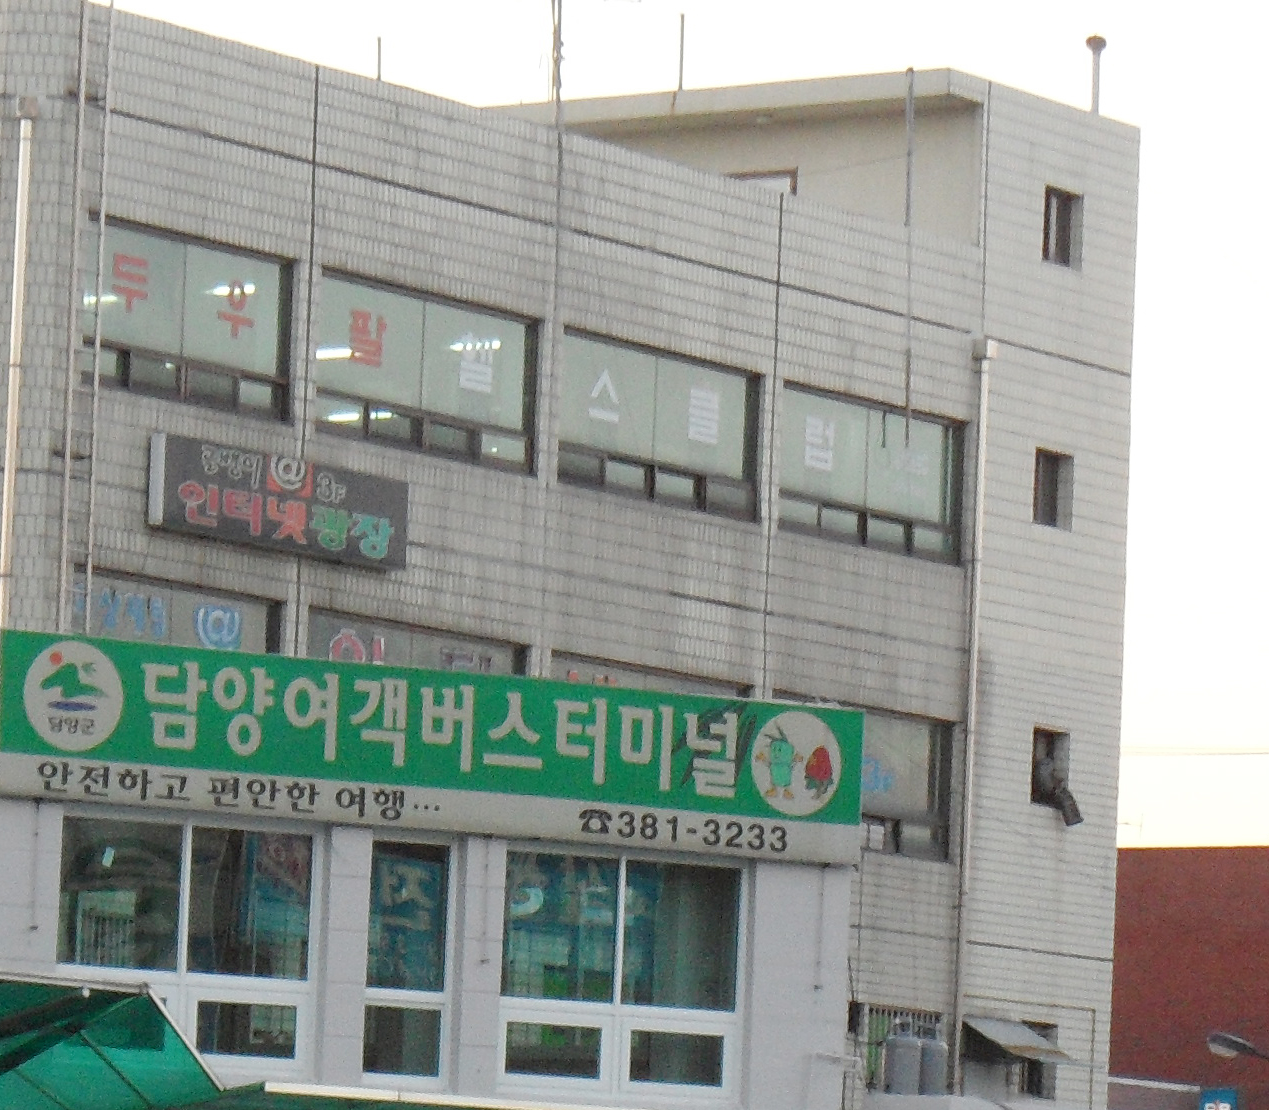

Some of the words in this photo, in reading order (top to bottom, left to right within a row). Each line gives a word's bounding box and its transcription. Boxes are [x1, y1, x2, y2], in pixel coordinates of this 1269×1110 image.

[177, 479, 395, 560] 인터넷광장
[48, 714, 97, 736] 담양군
[140, 660, 741, 799] 담양여객버스터미널
[36, 760, 191, 802] 안전하고
[207, 775, 321, 815] 편안한
[616, 809, 789, 853] 381-3233
